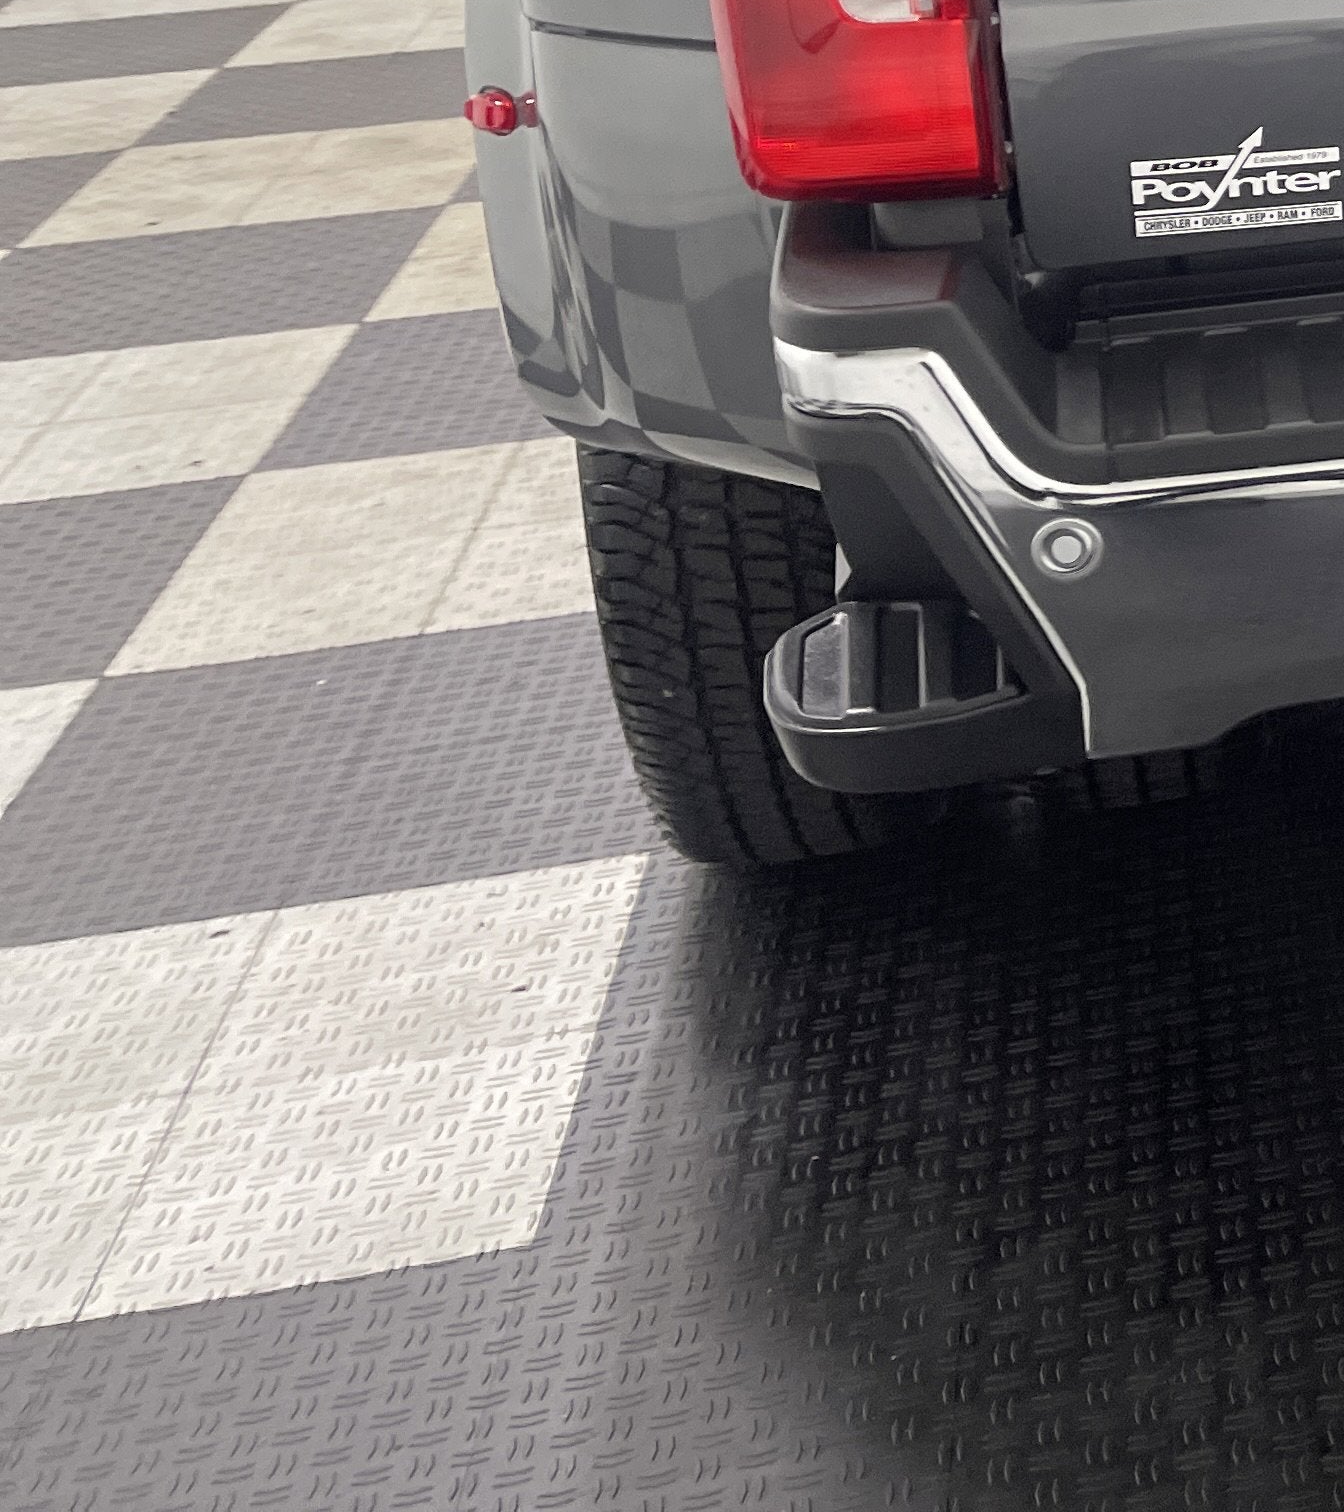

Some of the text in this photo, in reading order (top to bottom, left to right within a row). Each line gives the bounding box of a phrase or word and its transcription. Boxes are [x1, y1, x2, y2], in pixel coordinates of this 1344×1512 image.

[1150, 159, 1219, 172] BOB
[1131, 169, 1341, 210] Poynter
[1143, 207, 1335, 231] CHRYSLER DODGE JEEP RAM FORD
